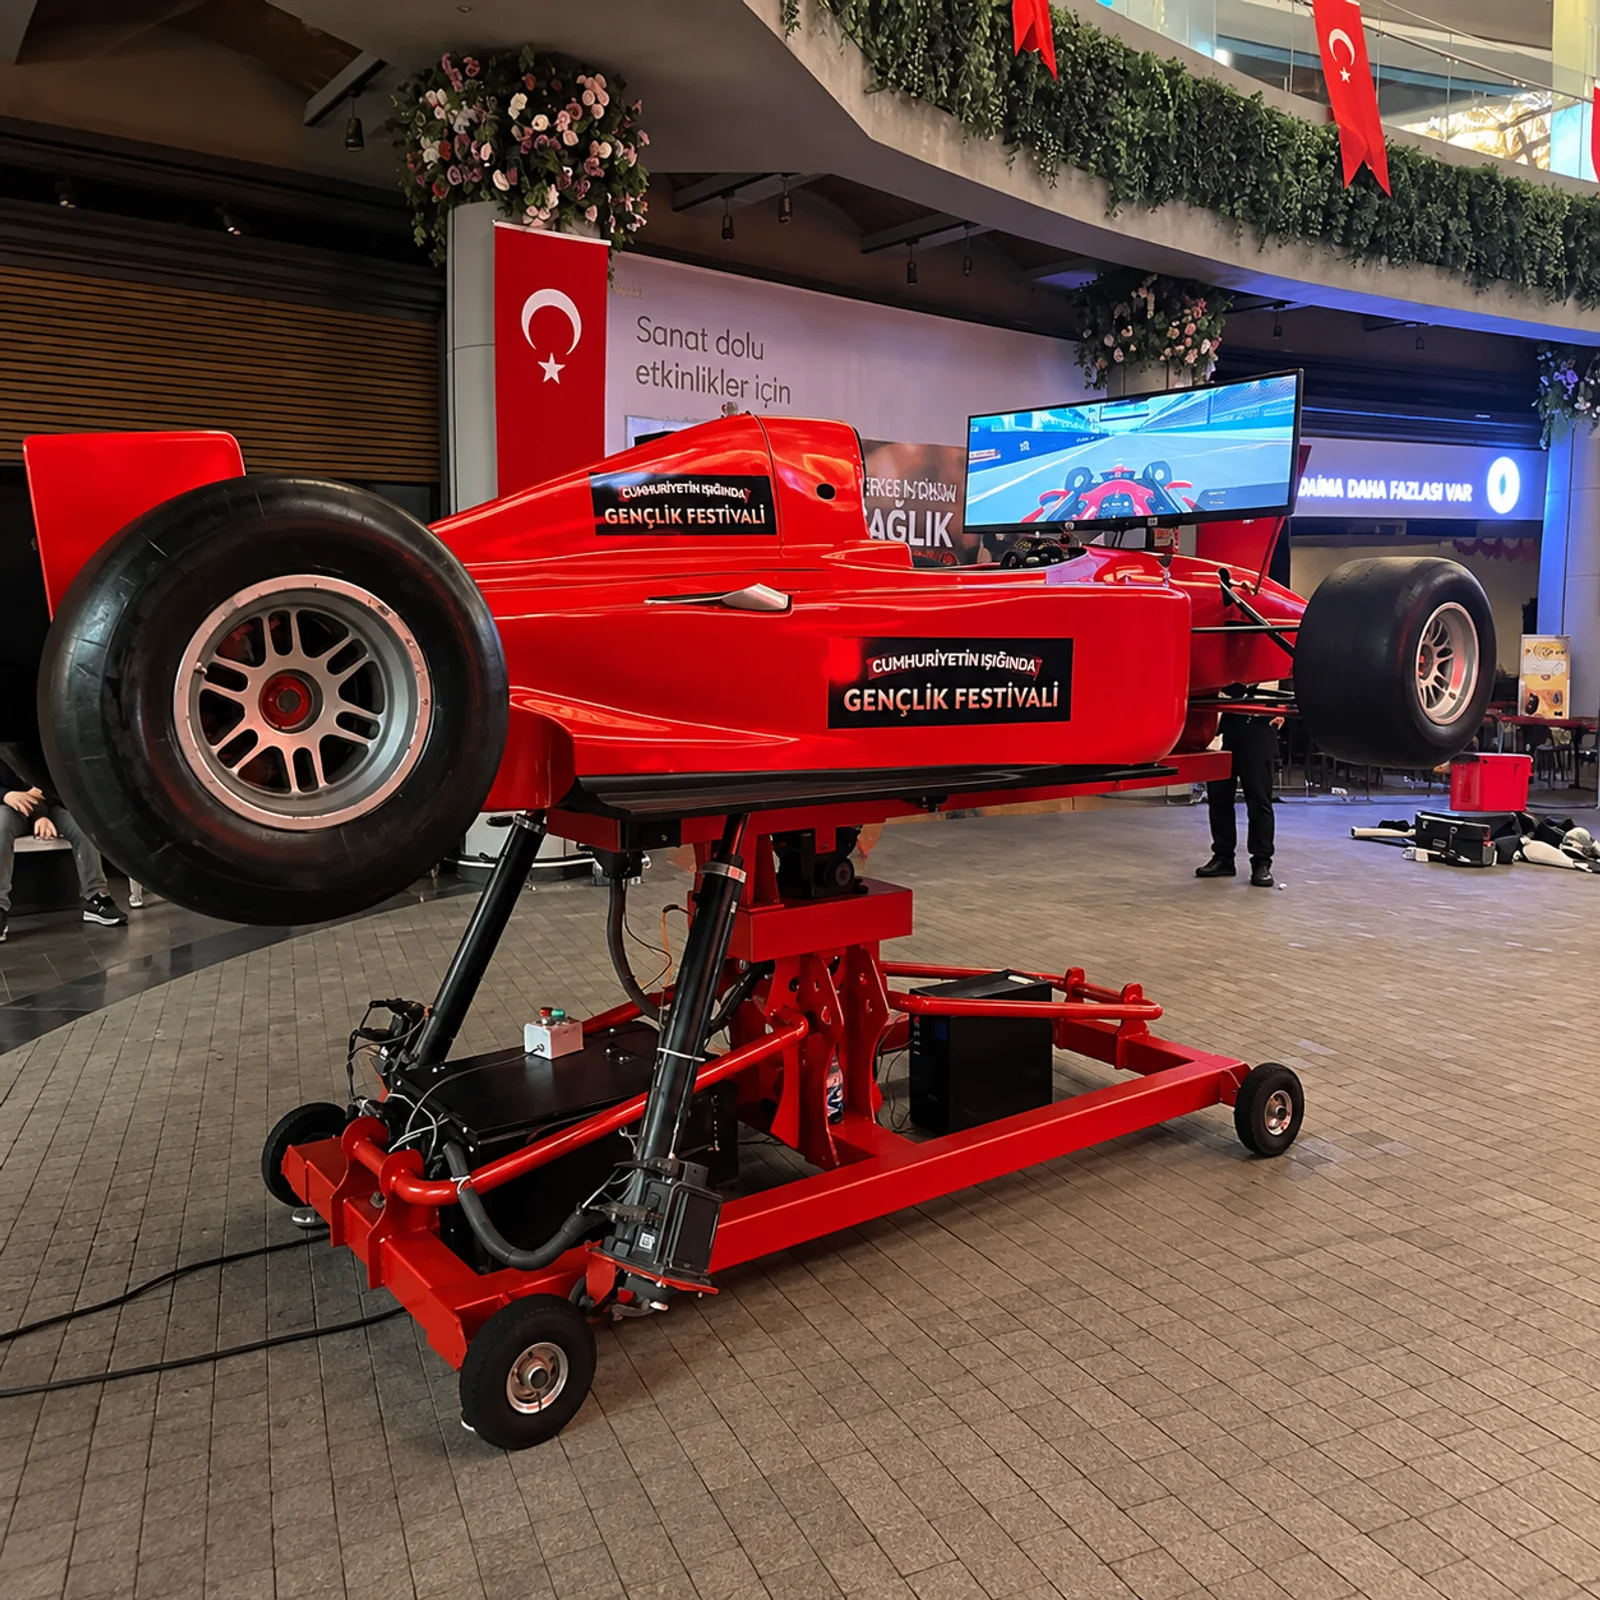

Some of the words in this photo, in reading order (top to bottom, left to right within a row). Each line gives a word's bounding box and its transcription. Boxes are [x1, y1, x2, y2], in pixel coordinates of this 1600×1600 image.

[636, 315, 708, 353] Sanat
[716, 329, 764, 361] dolu
[636, 360, 748, 398] etkinlikler
[755, 376, 791, 408] için
[1347, 478, 1387, 499] DAHA
[1446, 483, 1473, 502] VAR
[604, 504, 683, 530] GENÇLİK
[687, 504, 765, 525] FESTİVALİ
[864, 499, 954, 548] AĞLIK
[872, 648, 979, 673] CUMHURİYETİN
[981, 651, 1036, 672] IŞIĞINDA
[843, 683, 949, 717] GENÇLİK
[954, 681, 1059, 709] FESTİVALİ
